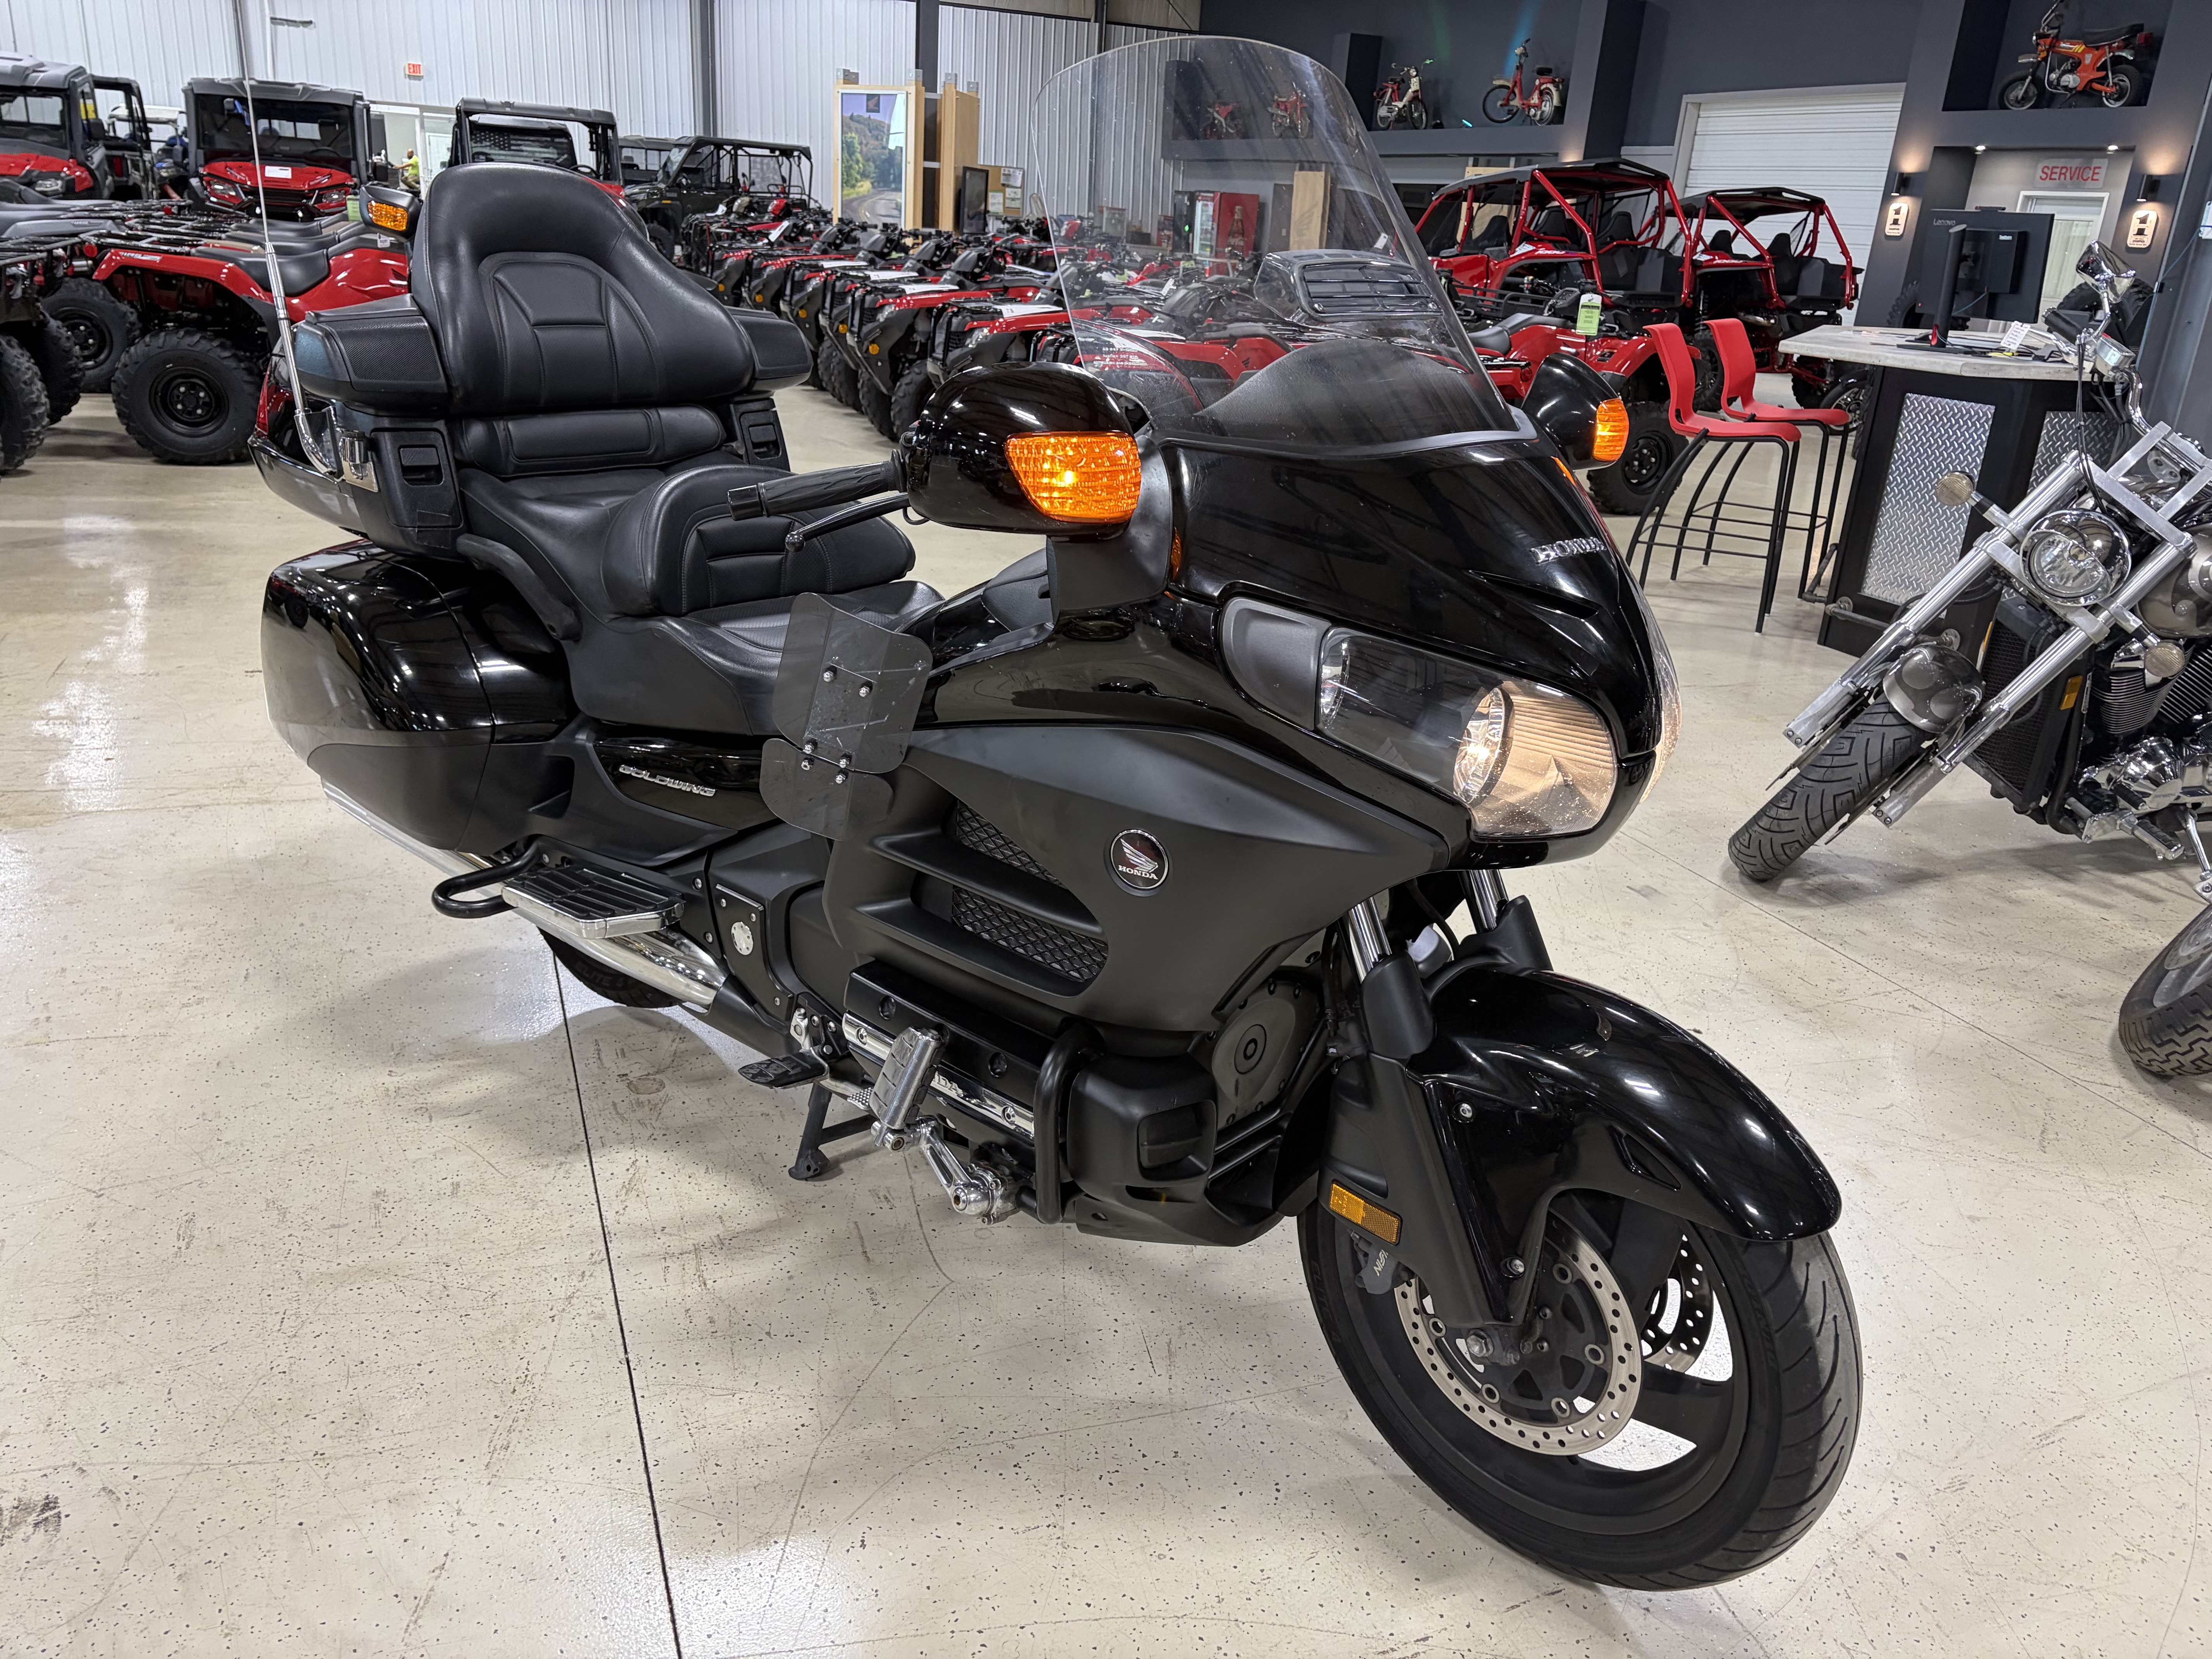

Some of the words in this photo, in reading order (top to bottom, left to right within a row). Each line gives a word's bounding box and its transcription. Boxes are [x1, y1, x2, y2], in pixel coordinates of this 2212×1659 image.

[408, 63, 421, 74] EXIT
[2039, 165, 2102, 181] SERVICE
[1933, 218, 1956, 226] Lenovo
[1530, 537, 1606, 563] HONDA
[1118, 865, 1158, 879] HONDA
[575, 961, 613, 986] ELITE
[1310, 1261, 1334, 1322] ELITE
